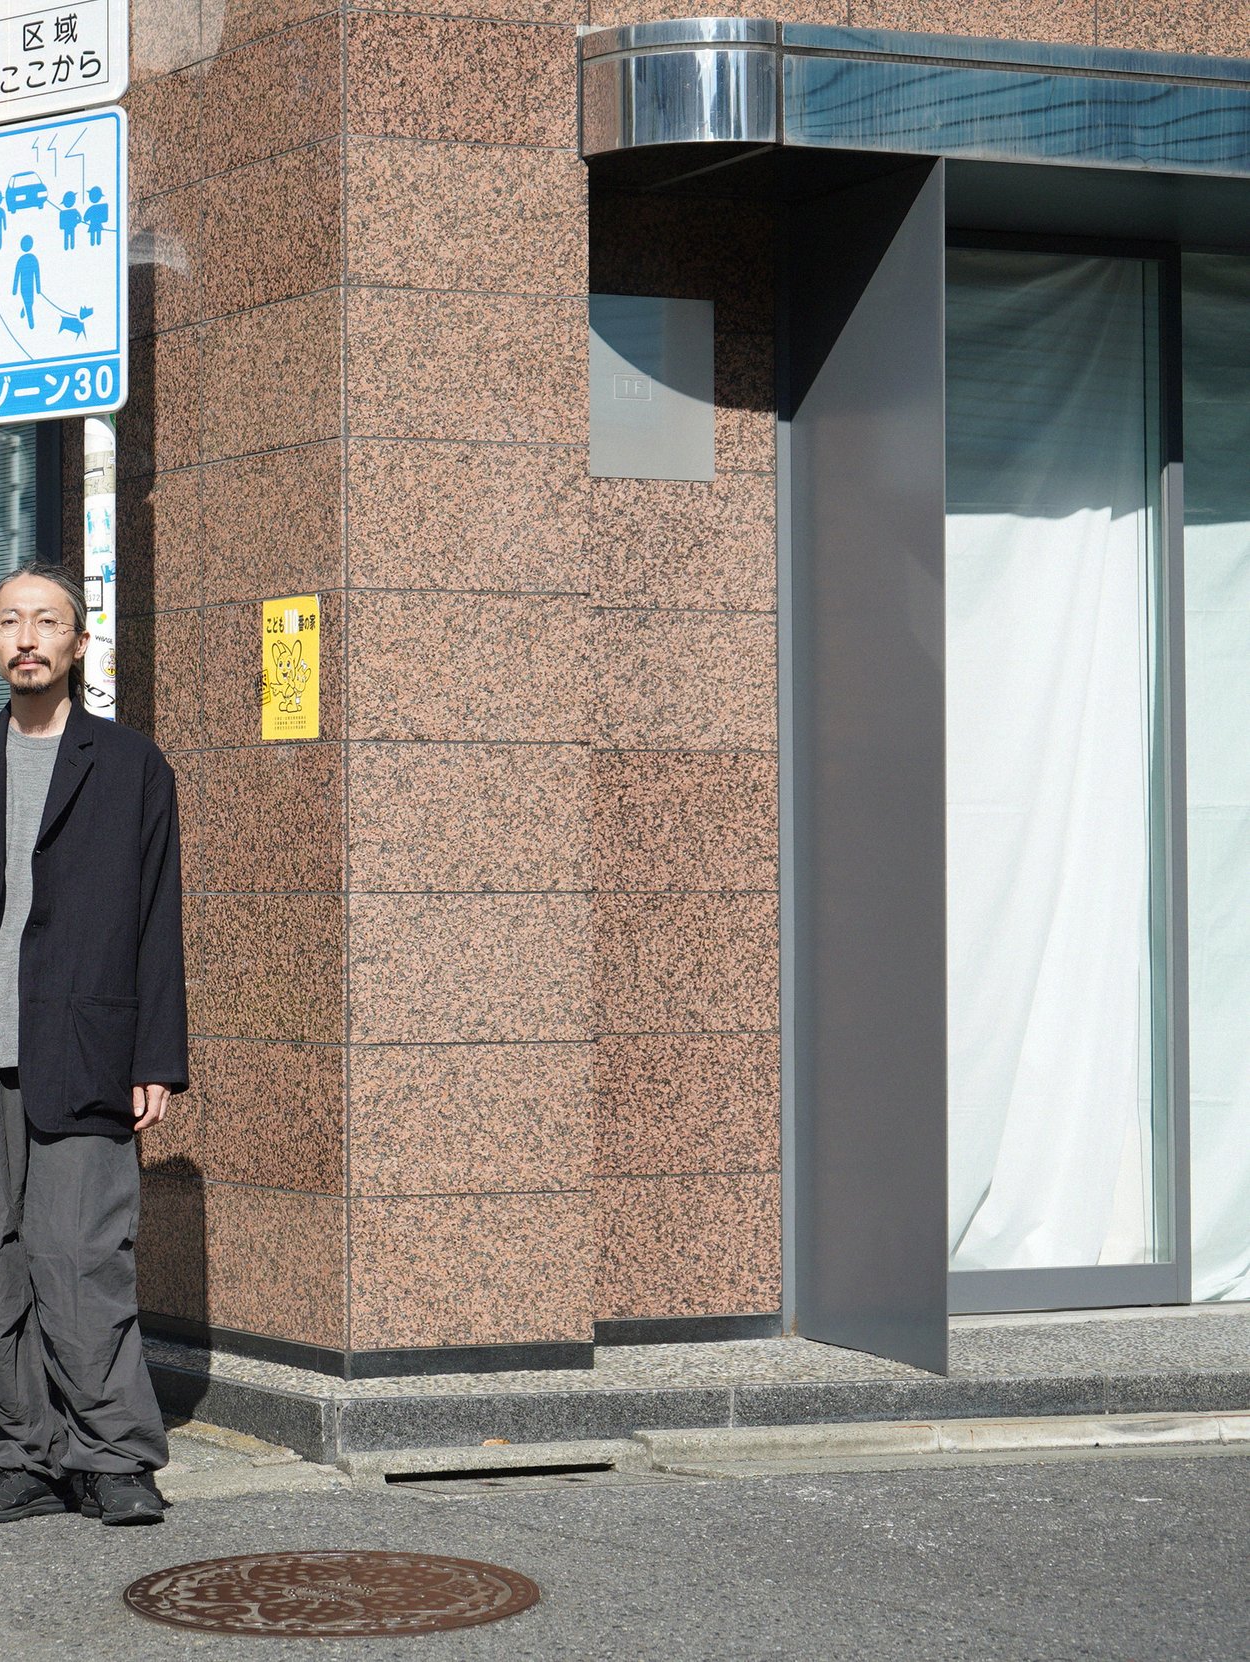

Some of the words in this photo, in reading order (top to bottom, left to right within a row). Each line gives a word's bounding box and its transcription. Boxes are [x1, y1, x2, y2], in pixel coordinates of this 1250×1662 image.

[23, 14, 78, 51] 区域
[0, 51, 102, 93] ここから
